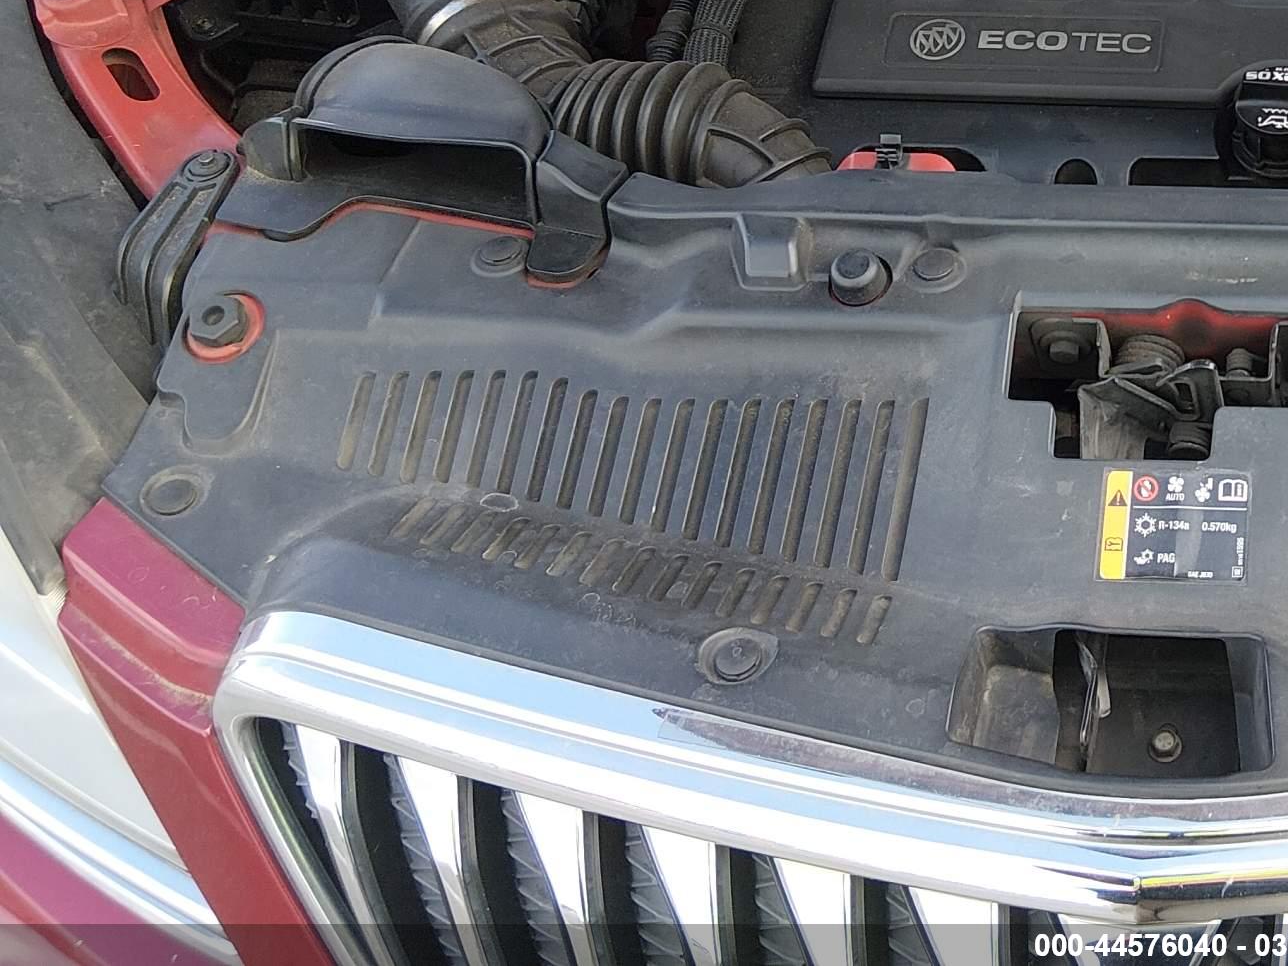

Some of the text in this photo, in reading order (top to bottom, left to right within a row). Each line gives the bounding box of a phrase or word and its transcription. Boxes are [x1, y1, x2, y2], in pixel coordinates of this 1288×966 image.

[977, 30, 1153, 54] ECOTEC
[1165, 493, 1185, 502] AUTO
[1201, 521, 1237, 534] 0.570kg
[1156, 552, 1176, 564] PAG
